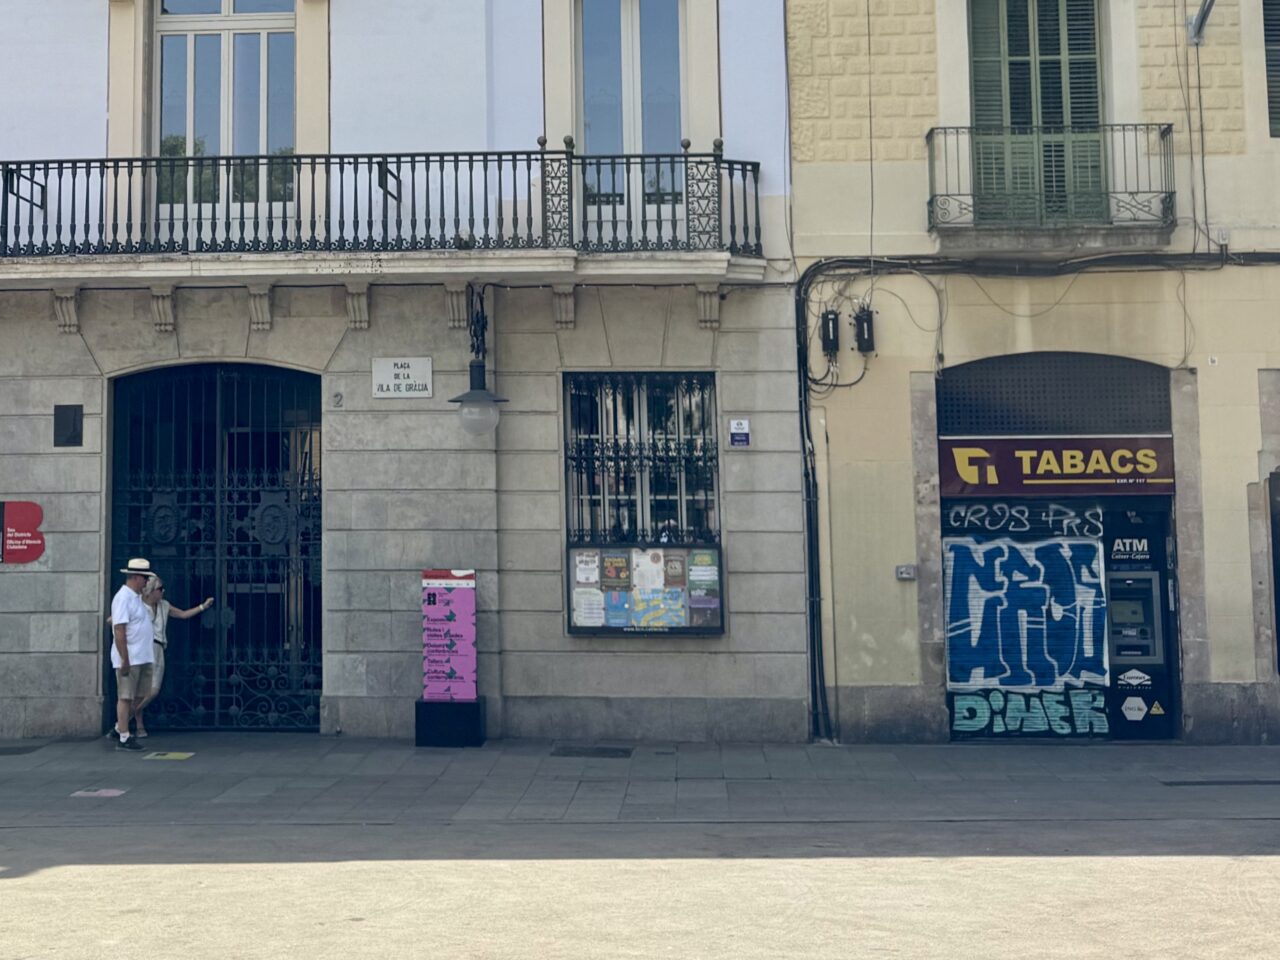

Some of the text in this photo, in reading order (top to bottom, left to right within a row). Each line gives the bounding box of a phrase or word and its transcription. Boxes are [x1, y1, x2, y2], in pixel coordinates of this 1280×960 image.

[393, 362, 410, 370] PLAÇA
[394, 383, 402, 392] DE
[333, 392, 343, 407] 2
[1014, 449, 1158, 475] TABACS
[1113, 538, 1148, 552] ATM
